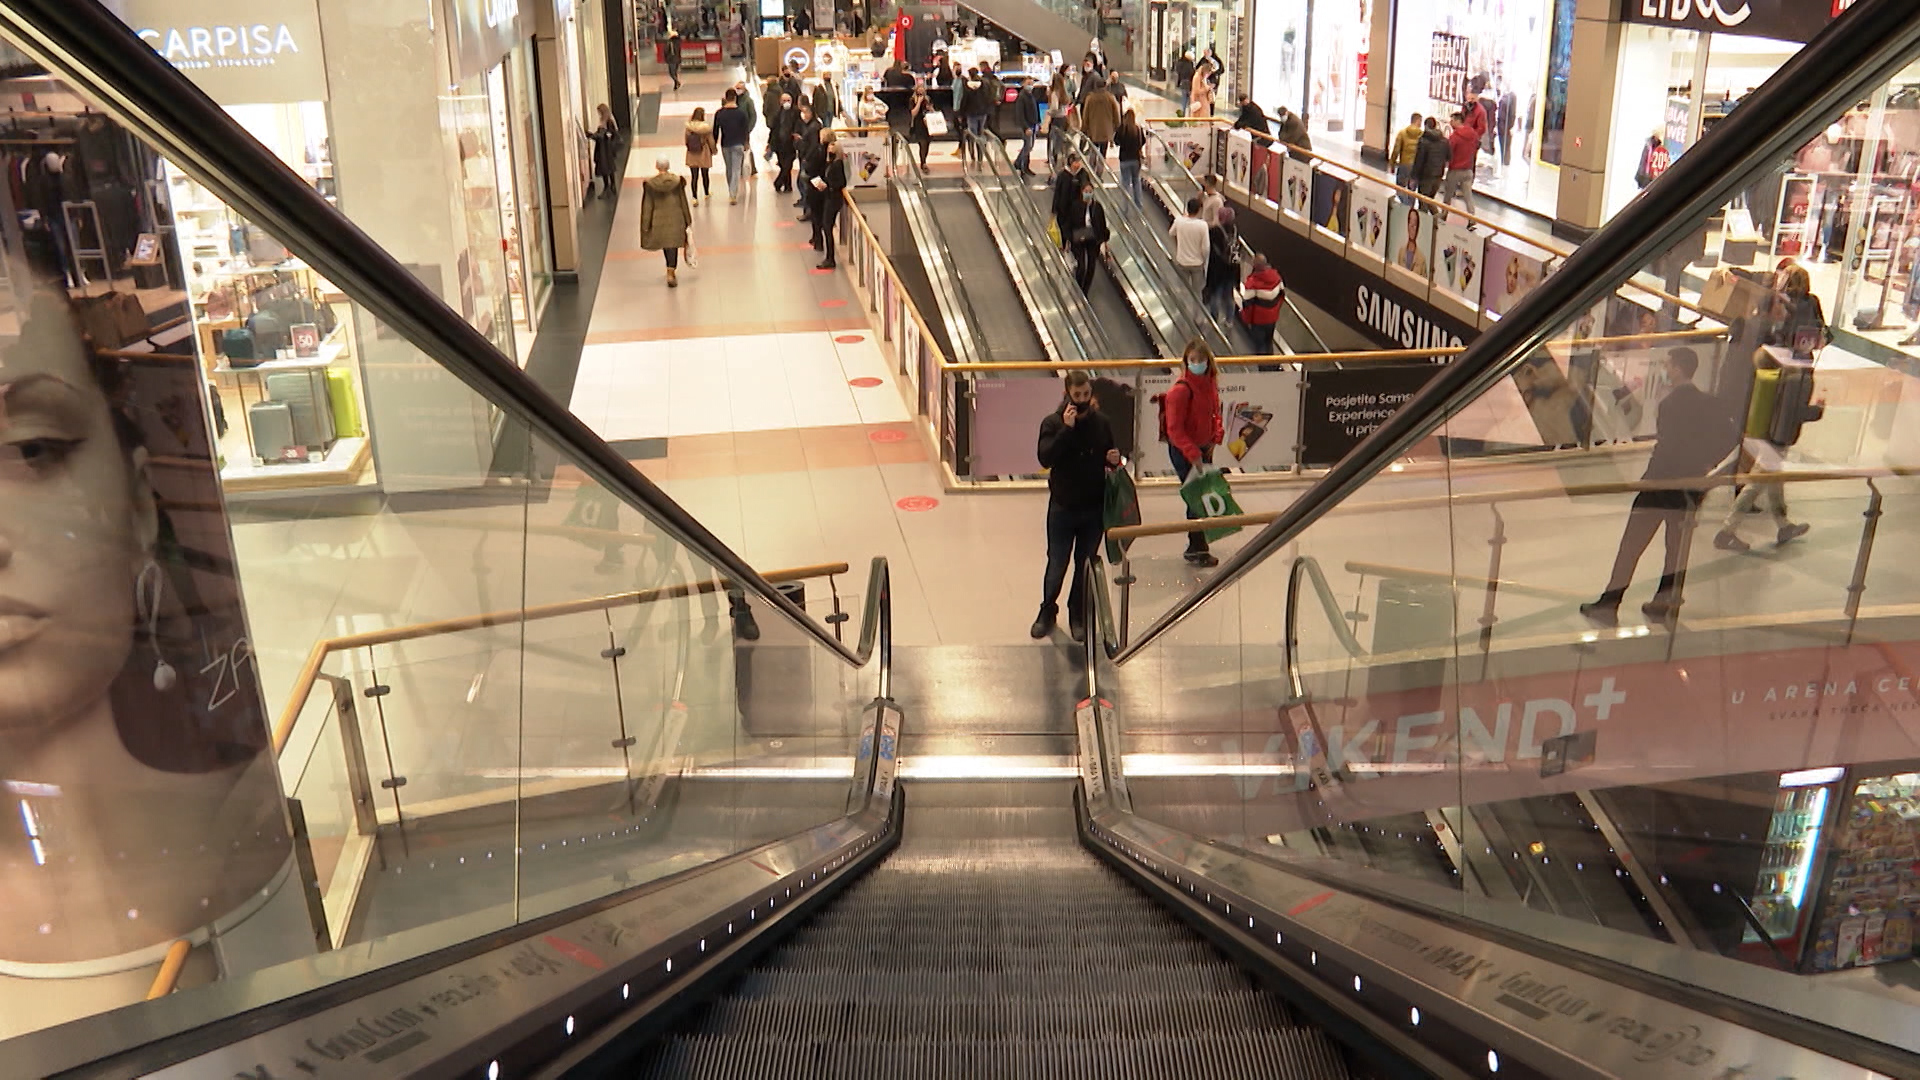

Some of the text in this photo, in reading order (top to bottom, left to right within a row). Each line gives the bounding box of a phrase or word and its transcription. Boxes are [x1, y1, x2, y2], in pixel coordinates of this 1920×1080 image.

[1430, 65, 1466, 104] WEEK
[1666, 124, 1687, 144] WEE
[1346, 426, 1354, 435] u
[1731, 690, 1746, 704] U
[1763, 681, 1858, 702] ARENA
